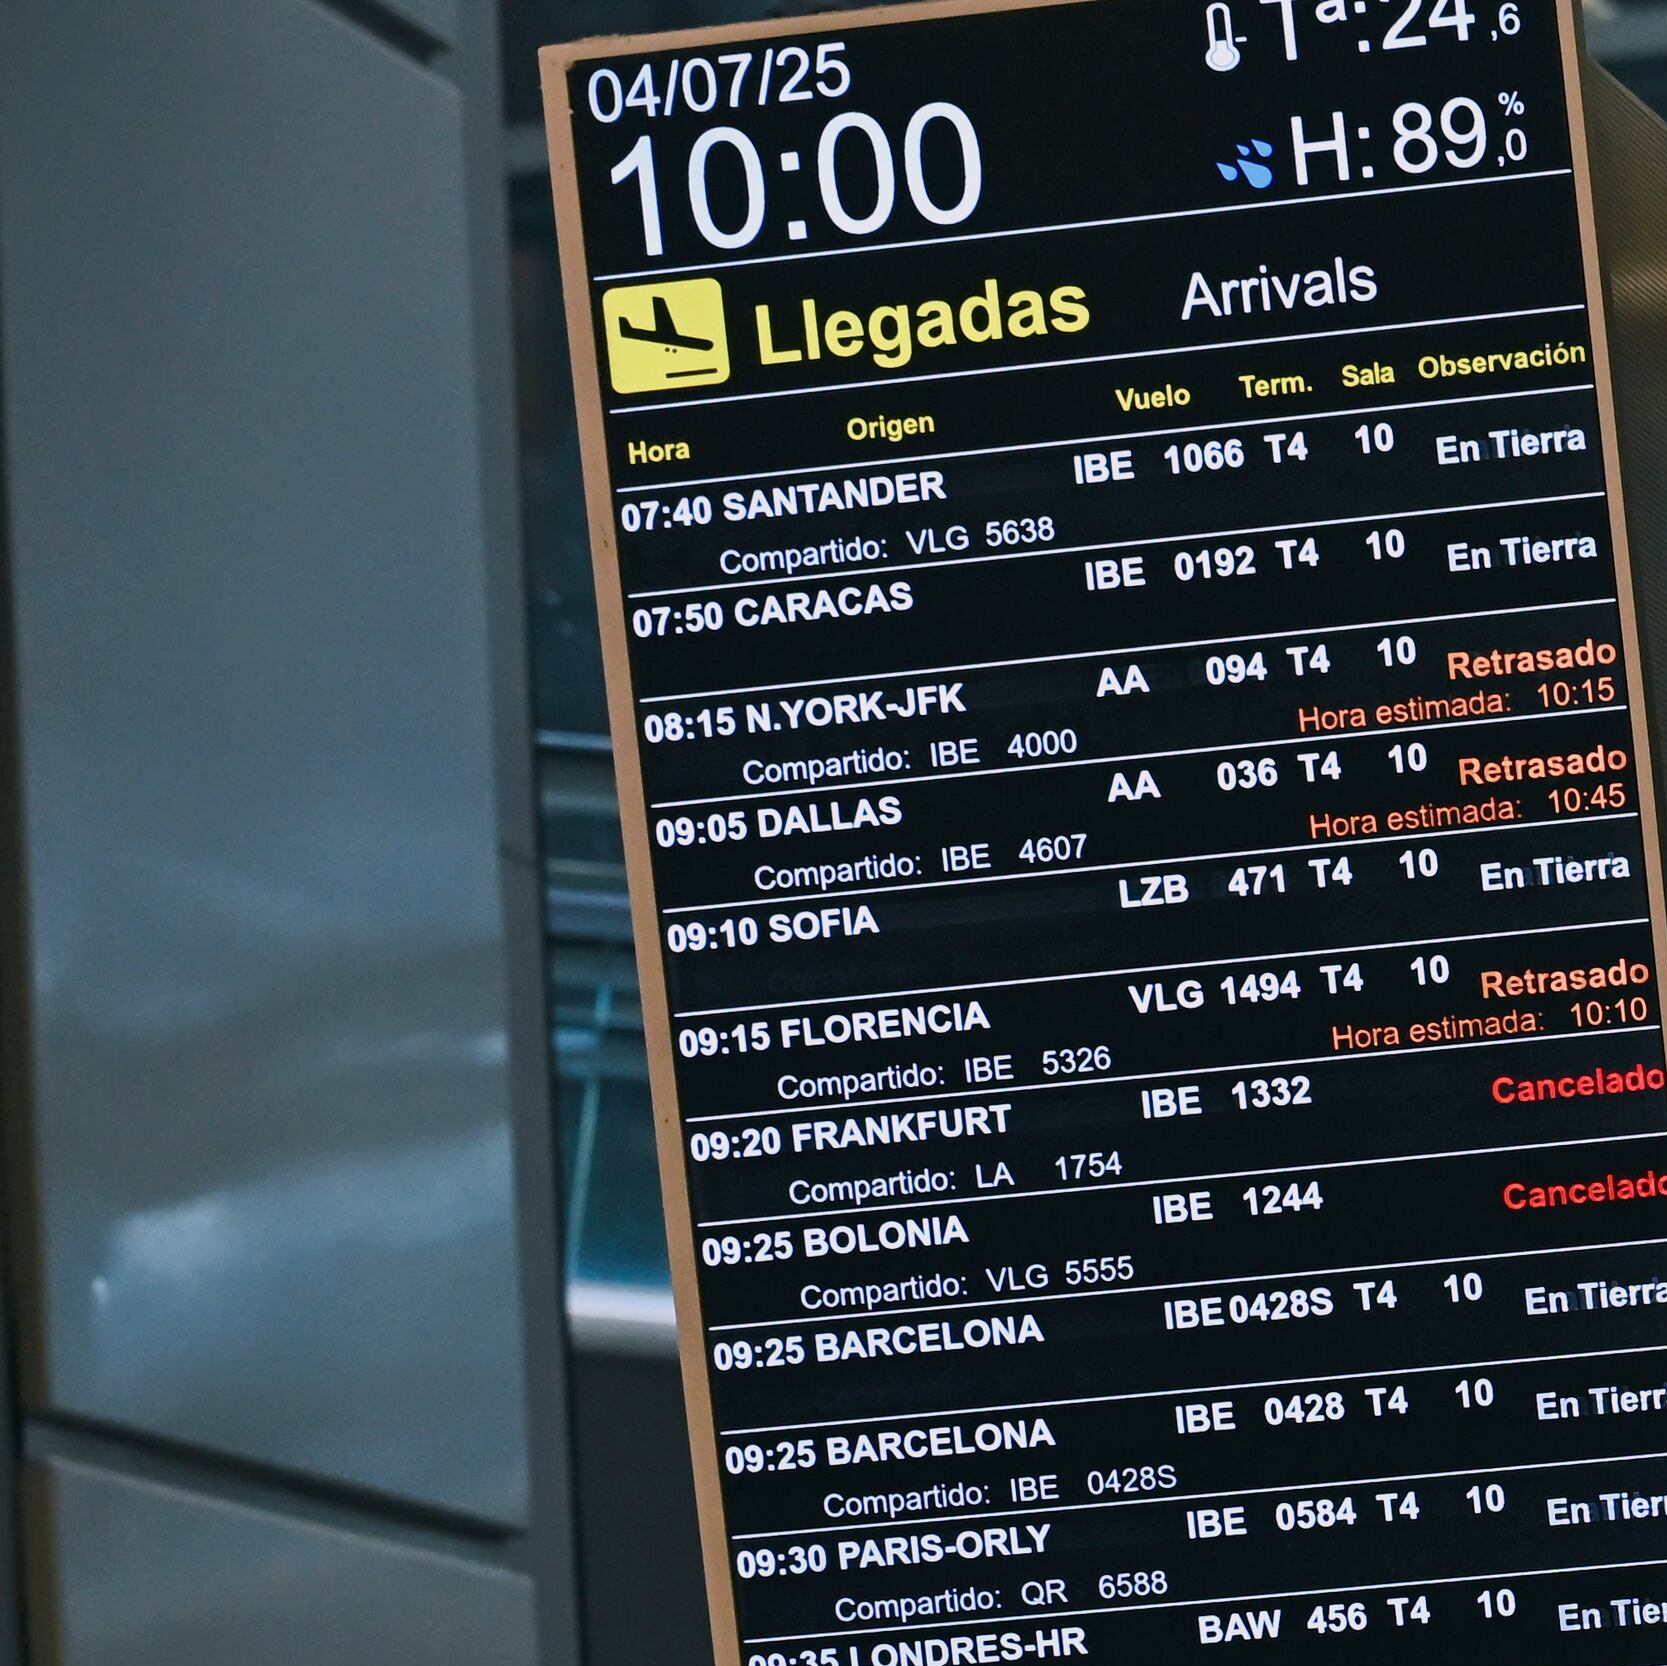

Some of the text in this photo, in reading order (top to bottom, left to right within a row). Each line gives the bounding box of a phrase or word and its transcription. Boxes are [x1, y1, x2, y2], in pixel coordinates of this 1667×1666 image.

[587, 41, 851, 124] 04/07/25
[610, 101, 982, 257] 10:00
[754, 278, 1090, 369] Llegadas
[1181, 256, 1378, 321] Arrivals
[627, 341, 1586, 465] Hora Origen Vuelo Term. Sala Observación
[621, 422, 1587, 533] 07:40 SANTANDER IBE 1066 T4 10 En Tierra
[719, 515, 1056, 575] Compartido: VLG 5638
[644, 635, 1617, 744] 08:15 N.YORK-JFK AA 094 T4 10 Retrasado
[1298, 676, 1615, 733] Hora estimada: 10:15
[690, 1063, 1665, 1162] 09:20 FRANKFURT IBE 1332 Cancelado
